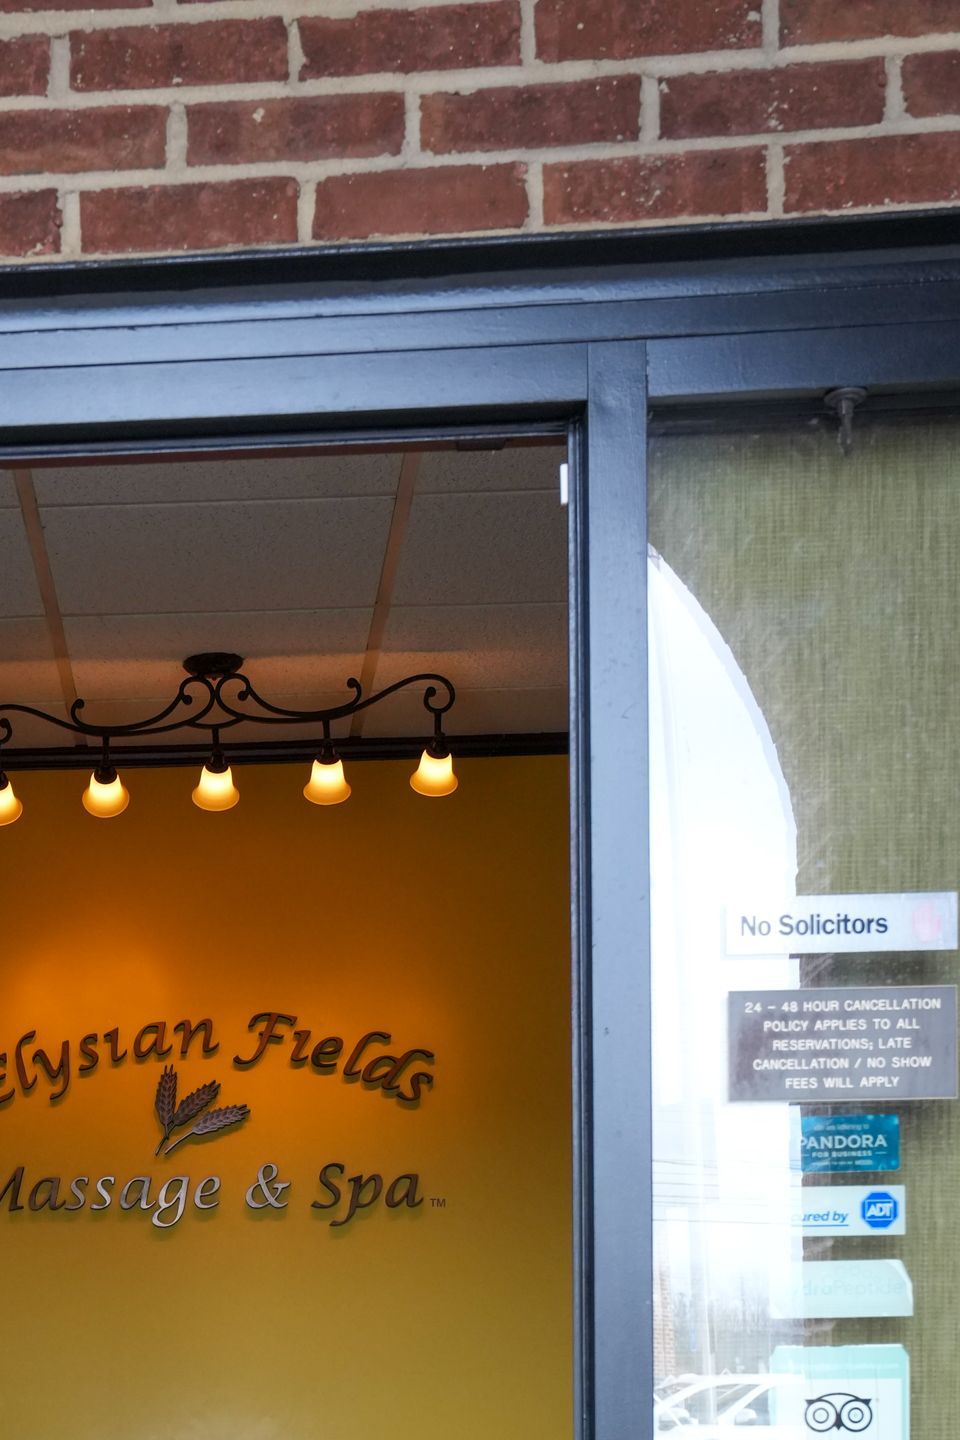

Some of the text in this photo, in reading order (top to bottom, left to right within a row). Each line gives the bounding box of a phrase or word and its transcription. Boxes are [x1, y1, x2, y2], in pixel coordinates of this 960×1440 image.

[741, 912, 889, 936] No Solicitors
[744, 1001, 762, 1013] 24
[781, 1000, 798, 1013] 48
[803, 1000, 840, 1012] HOUR
[844, 998, 942, 1012] CANCELLATION
[763, 1018, 920, 1032] POLICY APPLIES TO ALL
[772, 1037, 912, 1051] RESERVATIONS; LATE
[233, 1011, 435, 1102] Fields
[752, 1058, 849, 1070] CANCELLATION
[866, 1057, 886, 1068] NO
[891, 1056, 933, 1068] SHOW
[785, 1076, 900, 1089] FEES WILL APPLY
[800, 1134, 887, 1150] PANDORA
[245, 1162, 292, 1210] &
[311, 1162, 426, 1227] Spa
[832, 1209, 849, 1222] by
[866, 1204, 894, 1217] ADT
